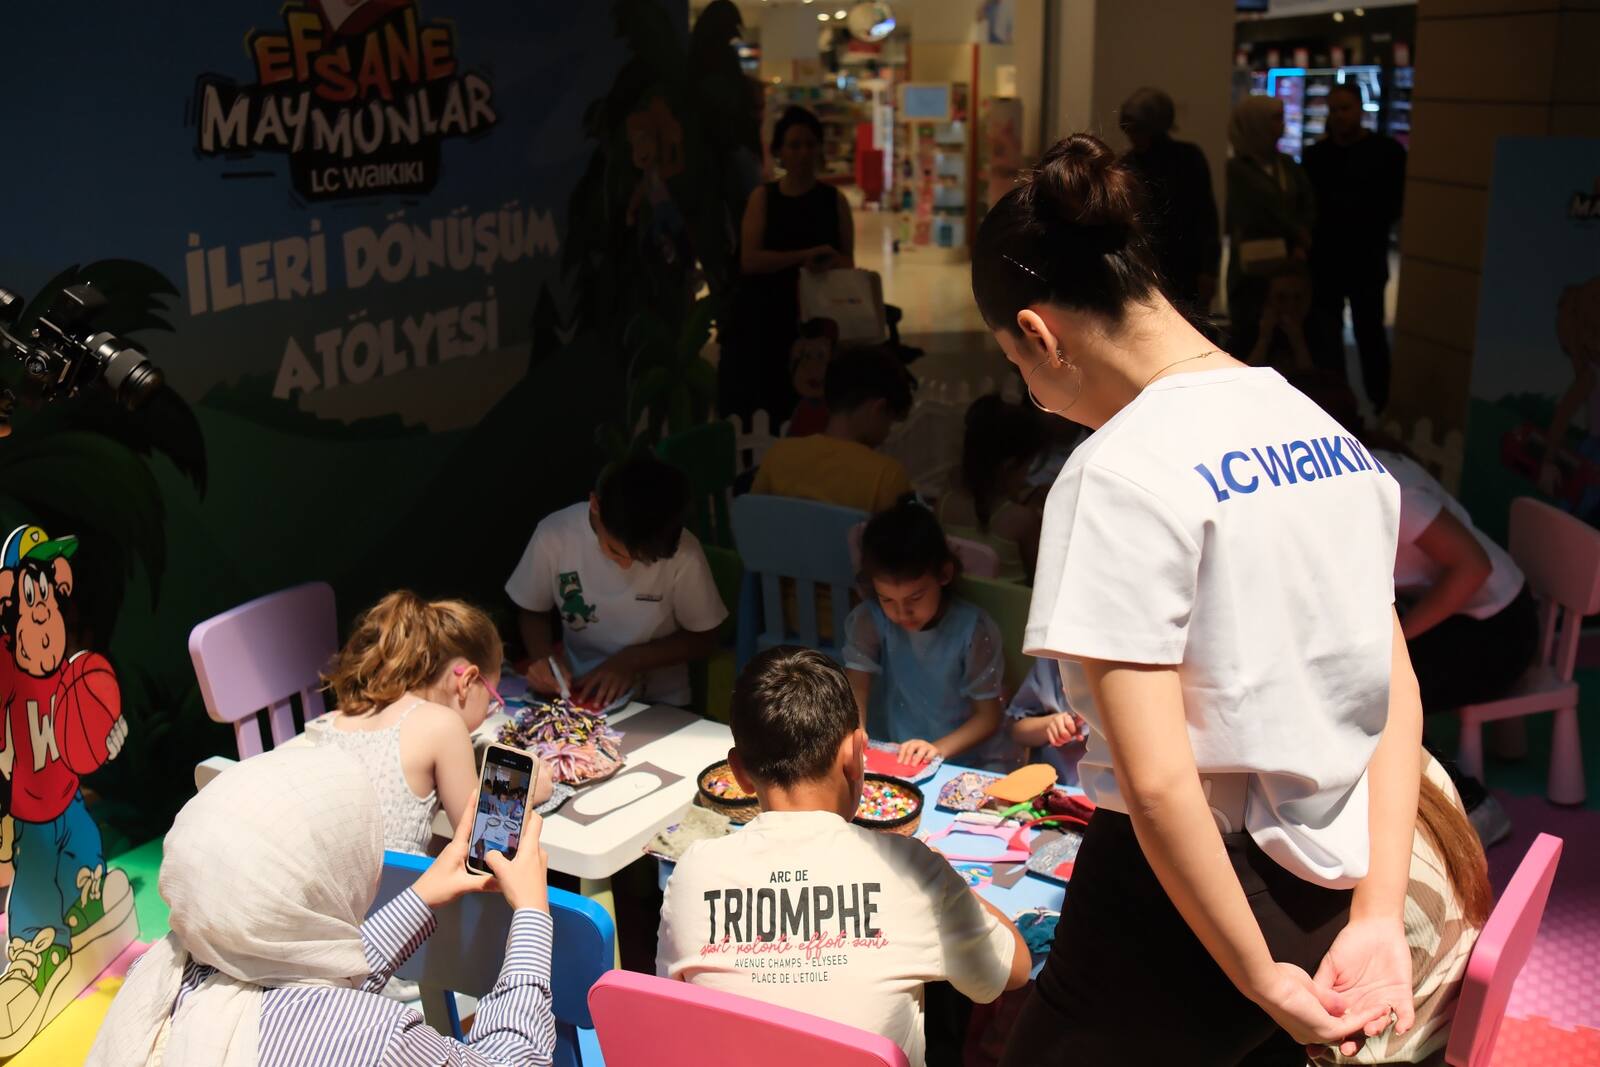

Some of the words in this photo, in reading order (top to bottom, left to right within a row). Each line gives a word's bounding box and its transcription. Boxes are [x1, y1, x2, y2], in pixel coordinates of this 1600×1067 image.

[253, 6, 457, 102] EFSANE
[201, 73, 497, 158] MAYMUNLAR
[310, 168, 341, 193] LC
[185, 217, 328, 316] İLERİ
[342, 200, 560, 289] DÖNÜŞÜM
[271, 285, 499, 400] ATÖLYESİ
[1193, 451, 1259, 503] LC
[769, 871, 791, 883] ARC
[794, 869, 808, 882] DE
[703, 882, 881, 944] TRIOMPHE
[699, 934, 731, 959] sport
[799, 931, 845, 960] effort
[734, 957, 765, 968] AVENUE
[768, 957, 802, 969] CHAMPS
[811, 954, 848, 967] ELYSEES
[751, 972, 777, 984] PLACE
[779, 972, 790, 984] DE
